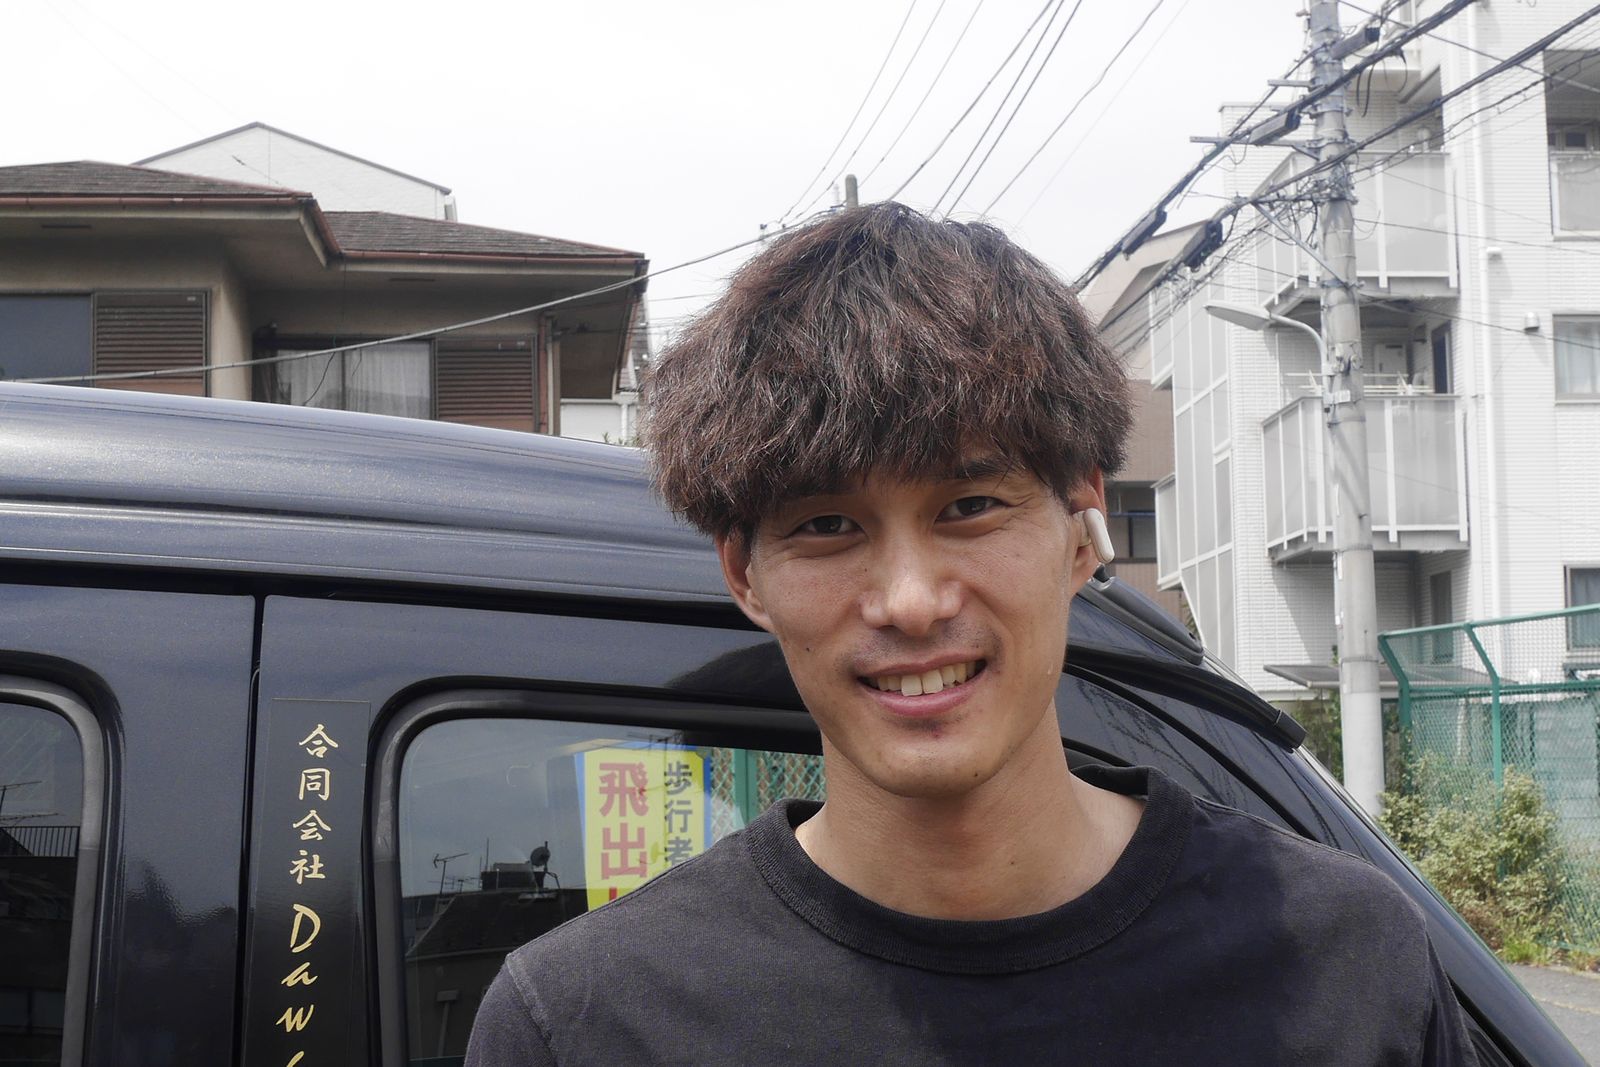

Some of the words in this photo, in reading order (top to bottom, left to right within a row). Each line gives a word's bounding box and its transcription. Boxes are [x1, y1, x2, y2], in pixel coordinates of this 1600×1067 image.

[289, 724, 339, 885] 合同会社
[599, 762, 648, 901] 飛出
[664, 761, 693, 866] 歩行者
